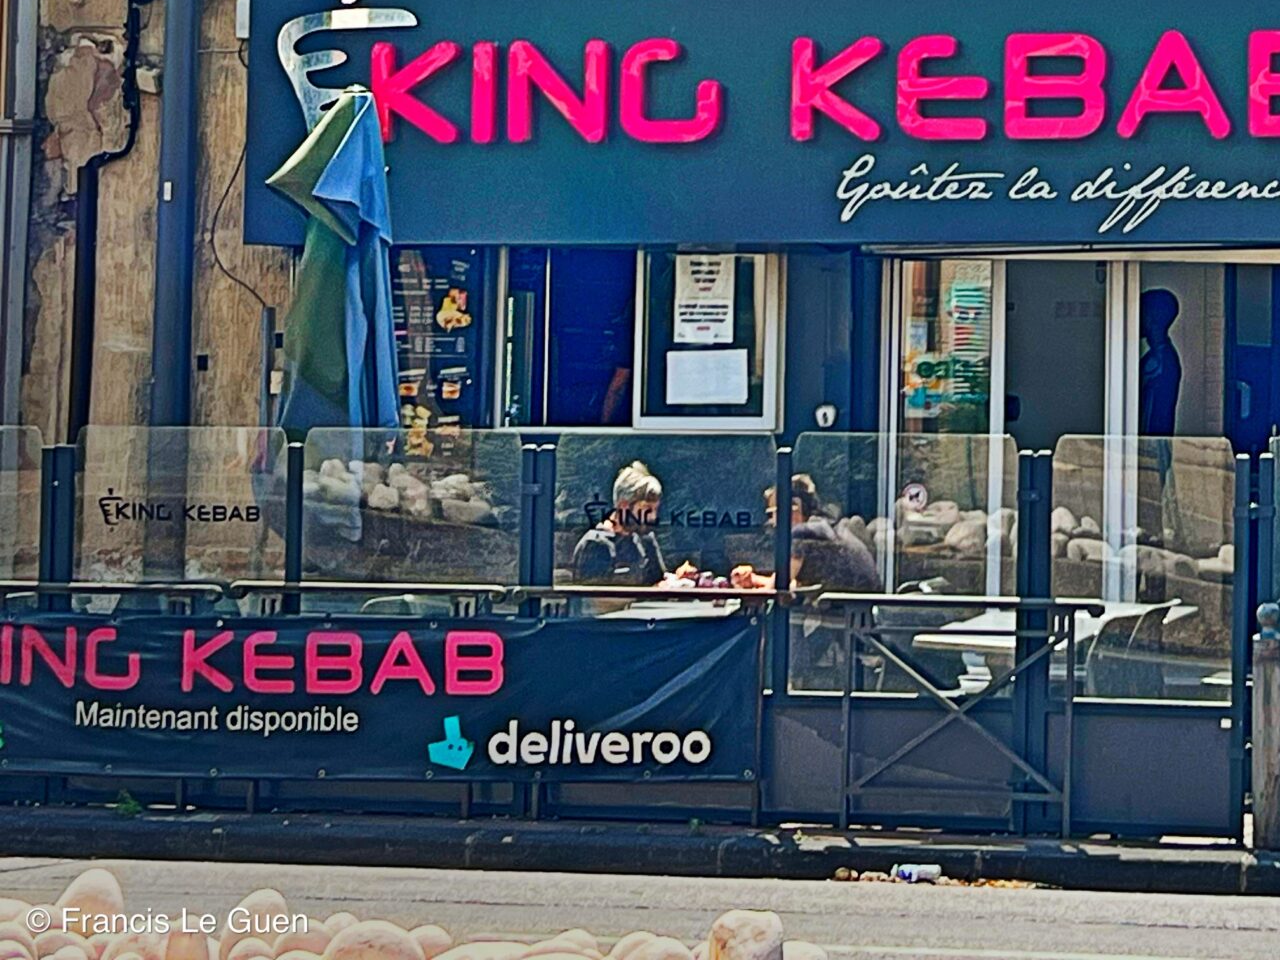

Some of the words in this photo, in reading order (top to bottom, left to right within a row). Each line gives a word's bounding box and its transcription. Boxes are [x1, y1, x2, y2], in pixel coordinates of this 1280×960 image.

[371, 38, 723, 143] KING
[836, 154, 1004, 222] Goûtez
[1008, 168, 1058, 200] la
[115, 502, 171, 521] KING
[183, 505, 261, 522] KEBAB
[670, 510, 752, 528] KEBAB
[0, 626, 140, 690] ING
[181, 629, 505, 696] KEBAB
[75, 701, 219, 730] Maintenant
[226, 706, 359, 737] disponible
[488, 720, 711, 764] deliveroo
